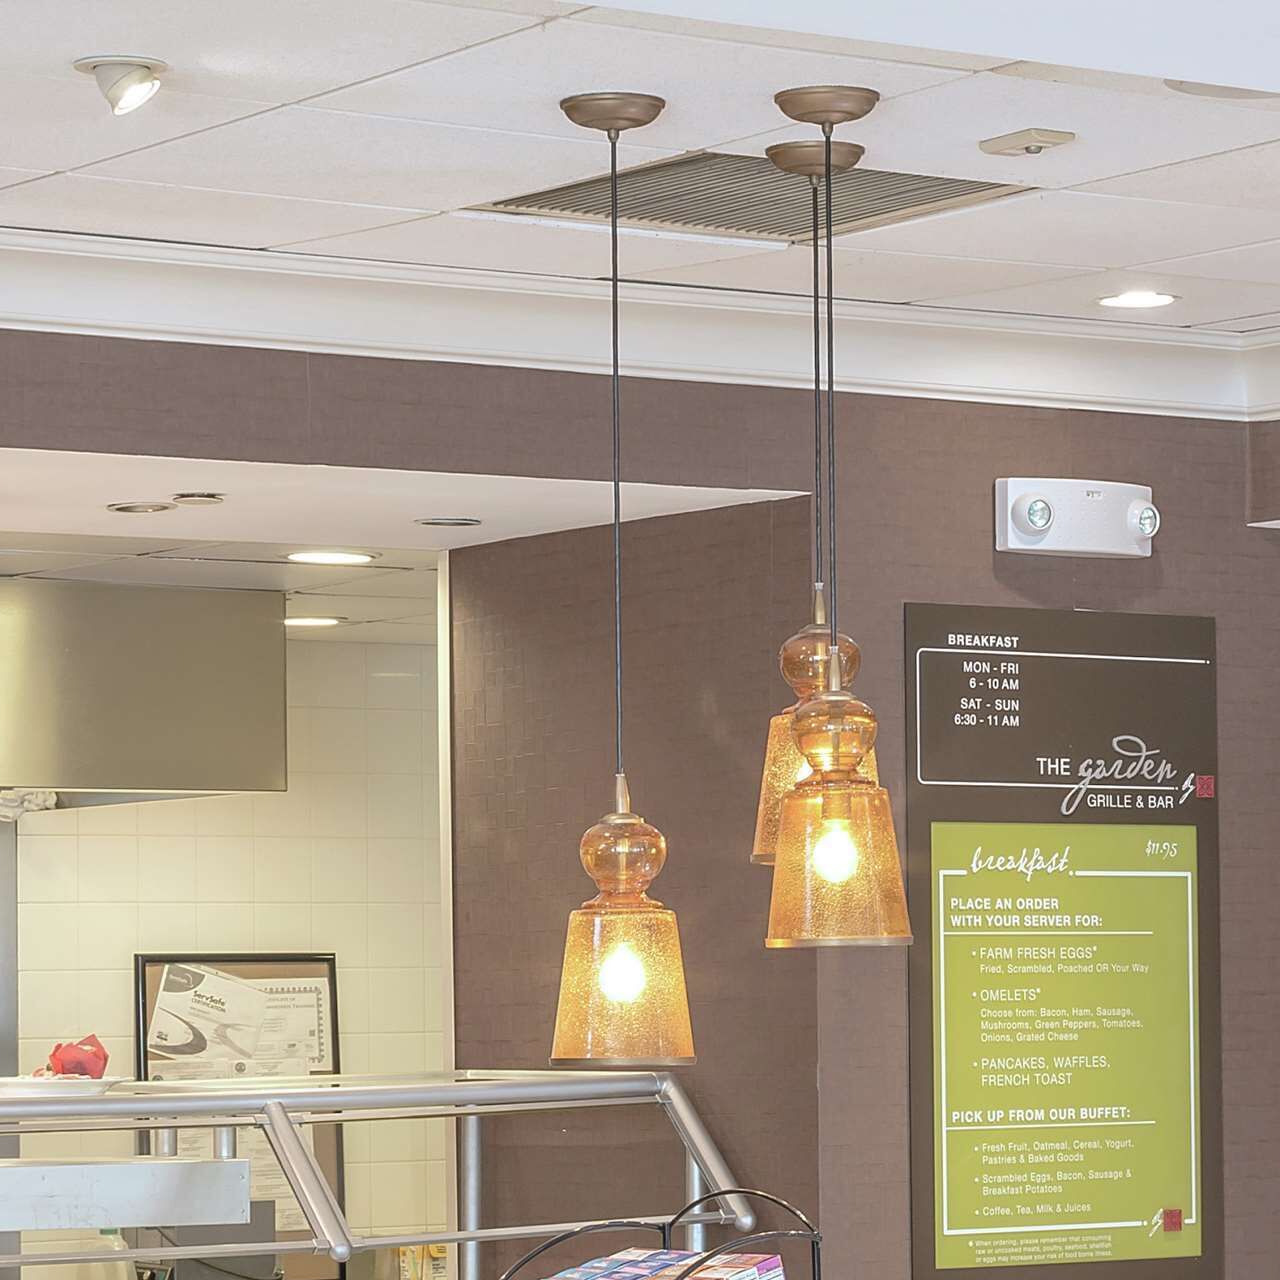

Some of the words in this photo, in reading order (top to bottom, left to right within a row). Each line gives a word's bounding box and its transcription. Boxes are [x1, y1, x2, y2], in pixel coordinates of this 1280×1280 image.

[948, 634, 1019, 648] BREAKFAST
[963, 661, 991, 673] MON
[1000, 662, 1019, 674] FRI
[969, 677, 977, 689] 6
[987, 678, 999, 689] 10
[1001, 678, 1020, 690] AM
[960, 698, 983, 710] SAT
[994, 699, 1020, 711] SUN
[954, 713, 977, 725] 6:30
[987, 714, 998, 726] 11
[1001, 715, 1020, 727] AM
[1036, 757, 1070, 776] THE
[1060, 735, 1177, 816] garden
[1087, 794, 1132, 808] GRILLE
[1135, 795, 1145, 808] &
[1148, 795, 1174, 809] BAR
[1145, 840, 1178, 860] $11.95
[951, 898, 991, 910] PLACE
[995, 898, 1012, 910] AN
[1016, 898, 1059, 910] ORDER
[951, 914, 982, 927] WITH
[985, 914, 1020, 927] YOUR
[1023, 914, 1071, 927] SERVER
[1075, 914, 1103, 927] FOR:
[980, 947, 1013, 959] FARM
[1017, 947, 1056, 959] FRESH
[980, 963, 1005, 975] Fried,
[1007, 963, 1055, 975] Scrambled,
[1057, 963, 1093, 973] Poached
[1096, 963, 1109, 973] OR
[1111, 963, 1129, 973] Your
[1132, 963, 1149, 974] Way
[194, 990, 225, 1007] ServSafe
[980, 1008, 1013, 1018] Choose
[1040, 1007, 1069, 1018] Bacon,
[980, 1020, 1032, 1031] Mushrooms,
[1035, 1020, 1060, 1030] Green
[980, 1032, 1014, 1043] Onions,
[1016, 1032, 1045, 1042] Grated
[1047, 1031, 1079, 1041] Cheese
[981, 1057, 1049, 1070] PANCAKES,
[1053, 1055, 1111, 1069] WAFFLES,
[981, 1074, 1030, 1087] FRENCH
[1034, 1072, 1072, 1085] TOAST
[952, 1110, 983, 1123] PICK
[987, 1109, 1005, 1122] UP
[1008, 1109, 1045, 1121] FROM
[1049, 1108, 1075, 1120] OUR
[1080, 1106, 1131, 1119] BUFFET:
[982, 1143, 1006, 1153] Fresh
[982, 1154, 1017, 1165] Pastries
[1028, 1153, 1054, 1163] Baked
[1056, 1152, 1084, 1162] Goods
[982, 1173, 1027, 1184] Scrambled
[1088, 1169, 1122, 1181] Sausage
[982, 1186, 1023, 1196] Breakfast
[1025, 1184, 1063, 1194] Potatoes
[982, 1206, 1014, 1216] Coffee,
[1036, 1204, 1054, 1214] Milk
[1064, 1202, 1091, 1213] Juices
